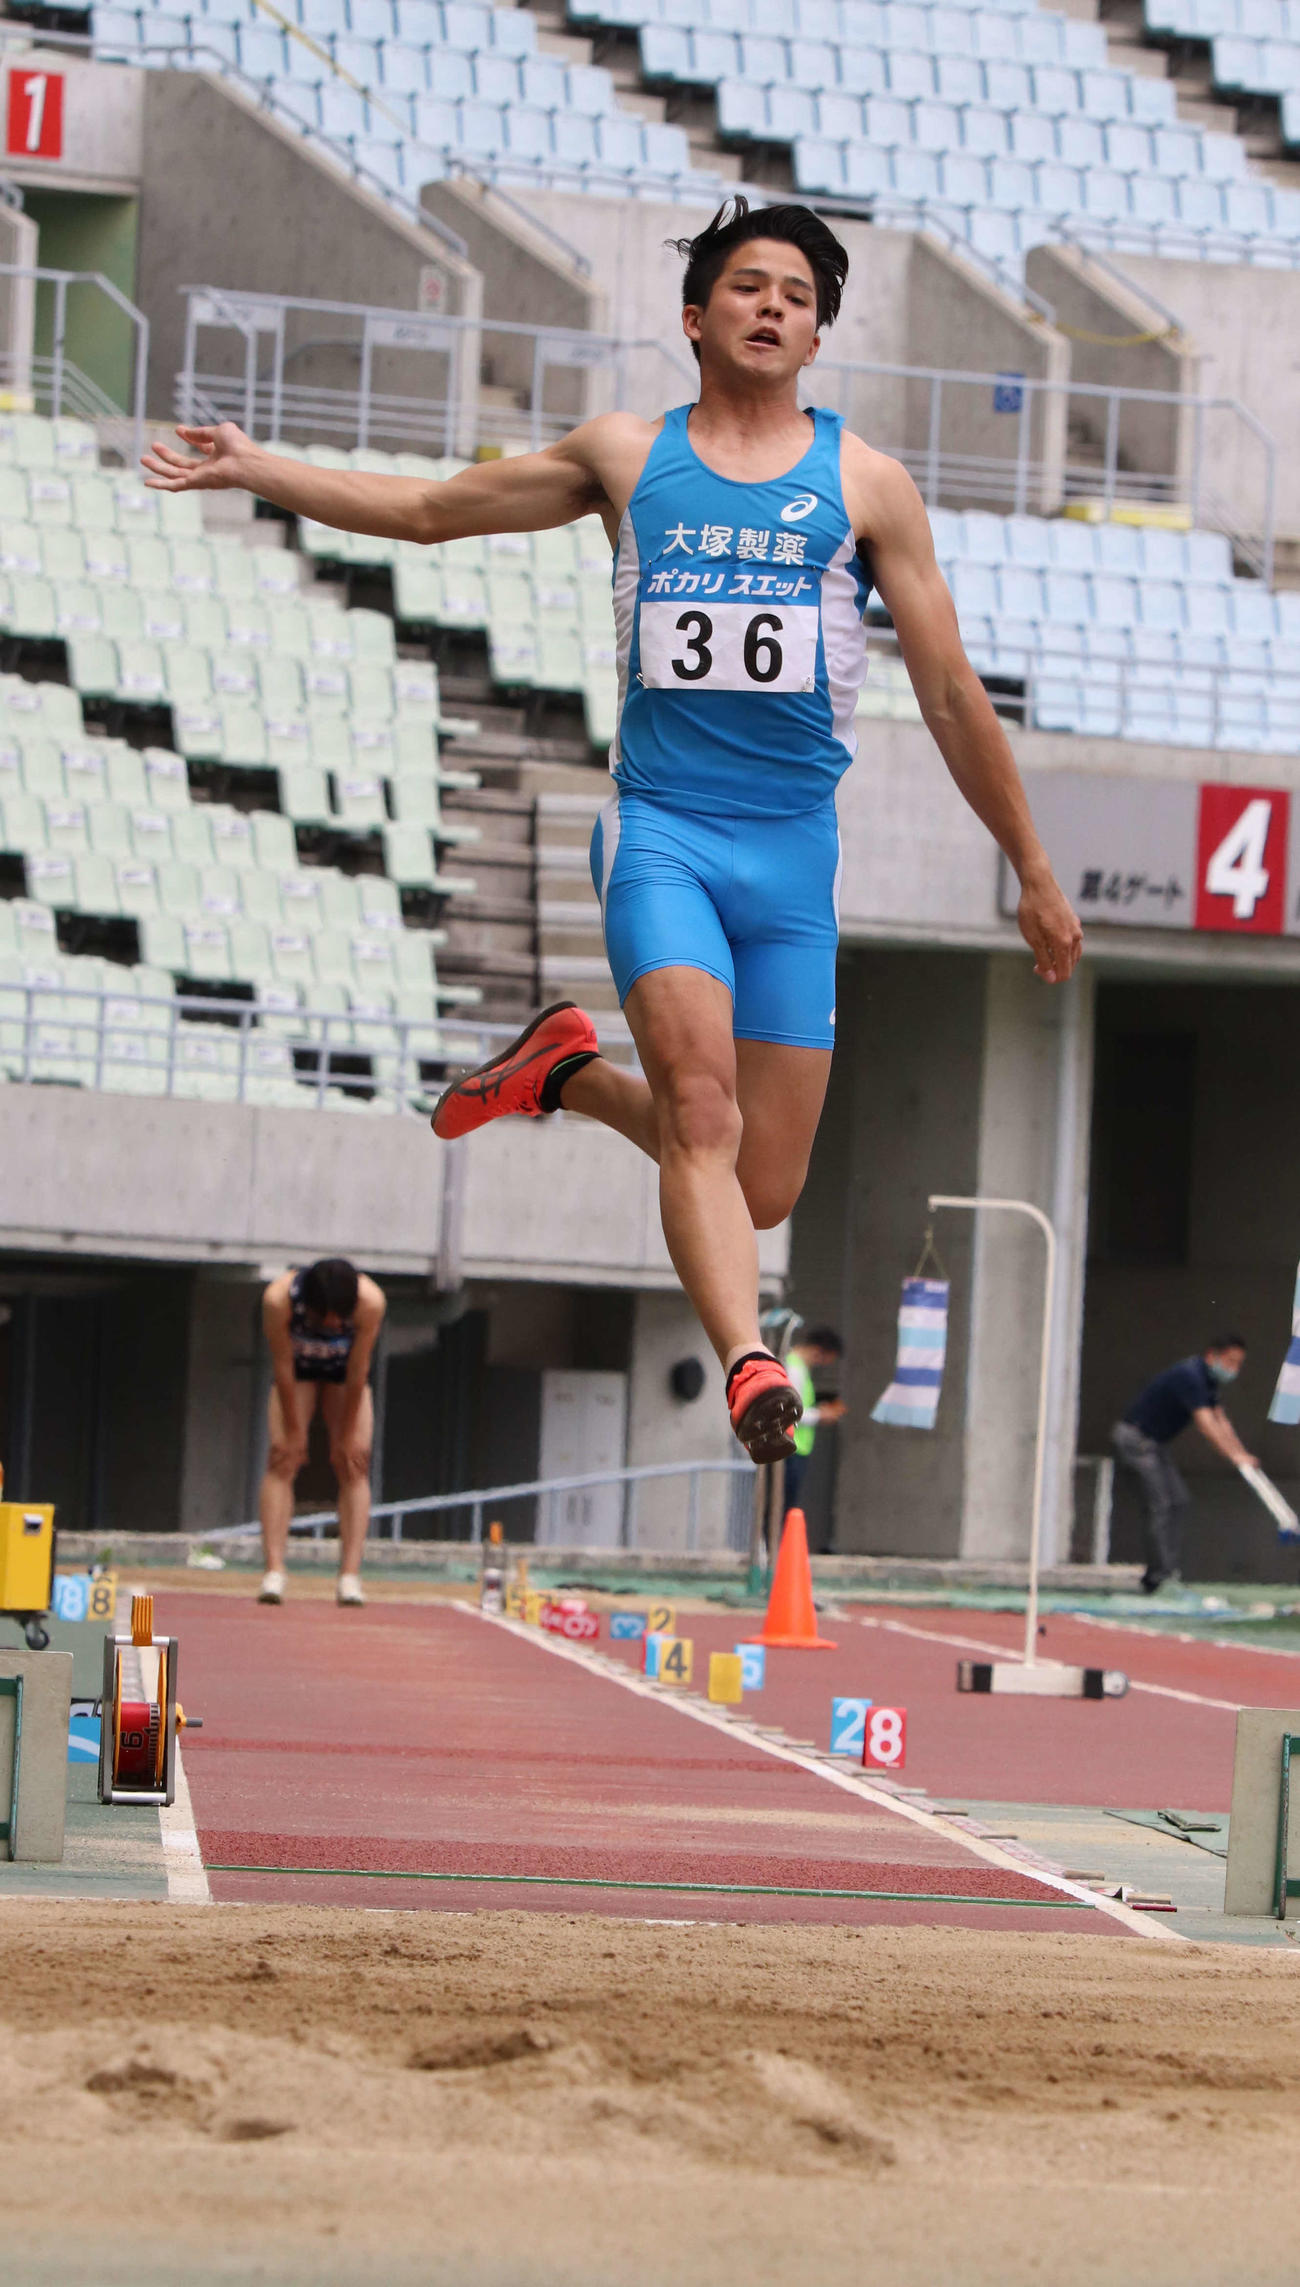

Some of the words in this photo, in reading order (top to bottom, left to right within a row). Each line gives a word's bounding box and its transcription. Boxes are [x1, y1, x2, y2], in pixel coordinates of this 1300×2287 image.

[23, 74, 48, 153] 1
[662, 522, 808, 566] 大塚製薬
[647, 568, 726, 594] ポカリ
[727, 575, 813, 597] スエット
[1205, 798, 1272, 919] 4
[61, 1584, 84, 1619] 8
[92, 1588, 110, 1616] 8
[664, 1641, 688, 1679] 4
[738, 1648, 763, 1685] 5
[834, 1700, 867, 1752] 2
[869, 1708, 903, 1763] 8
